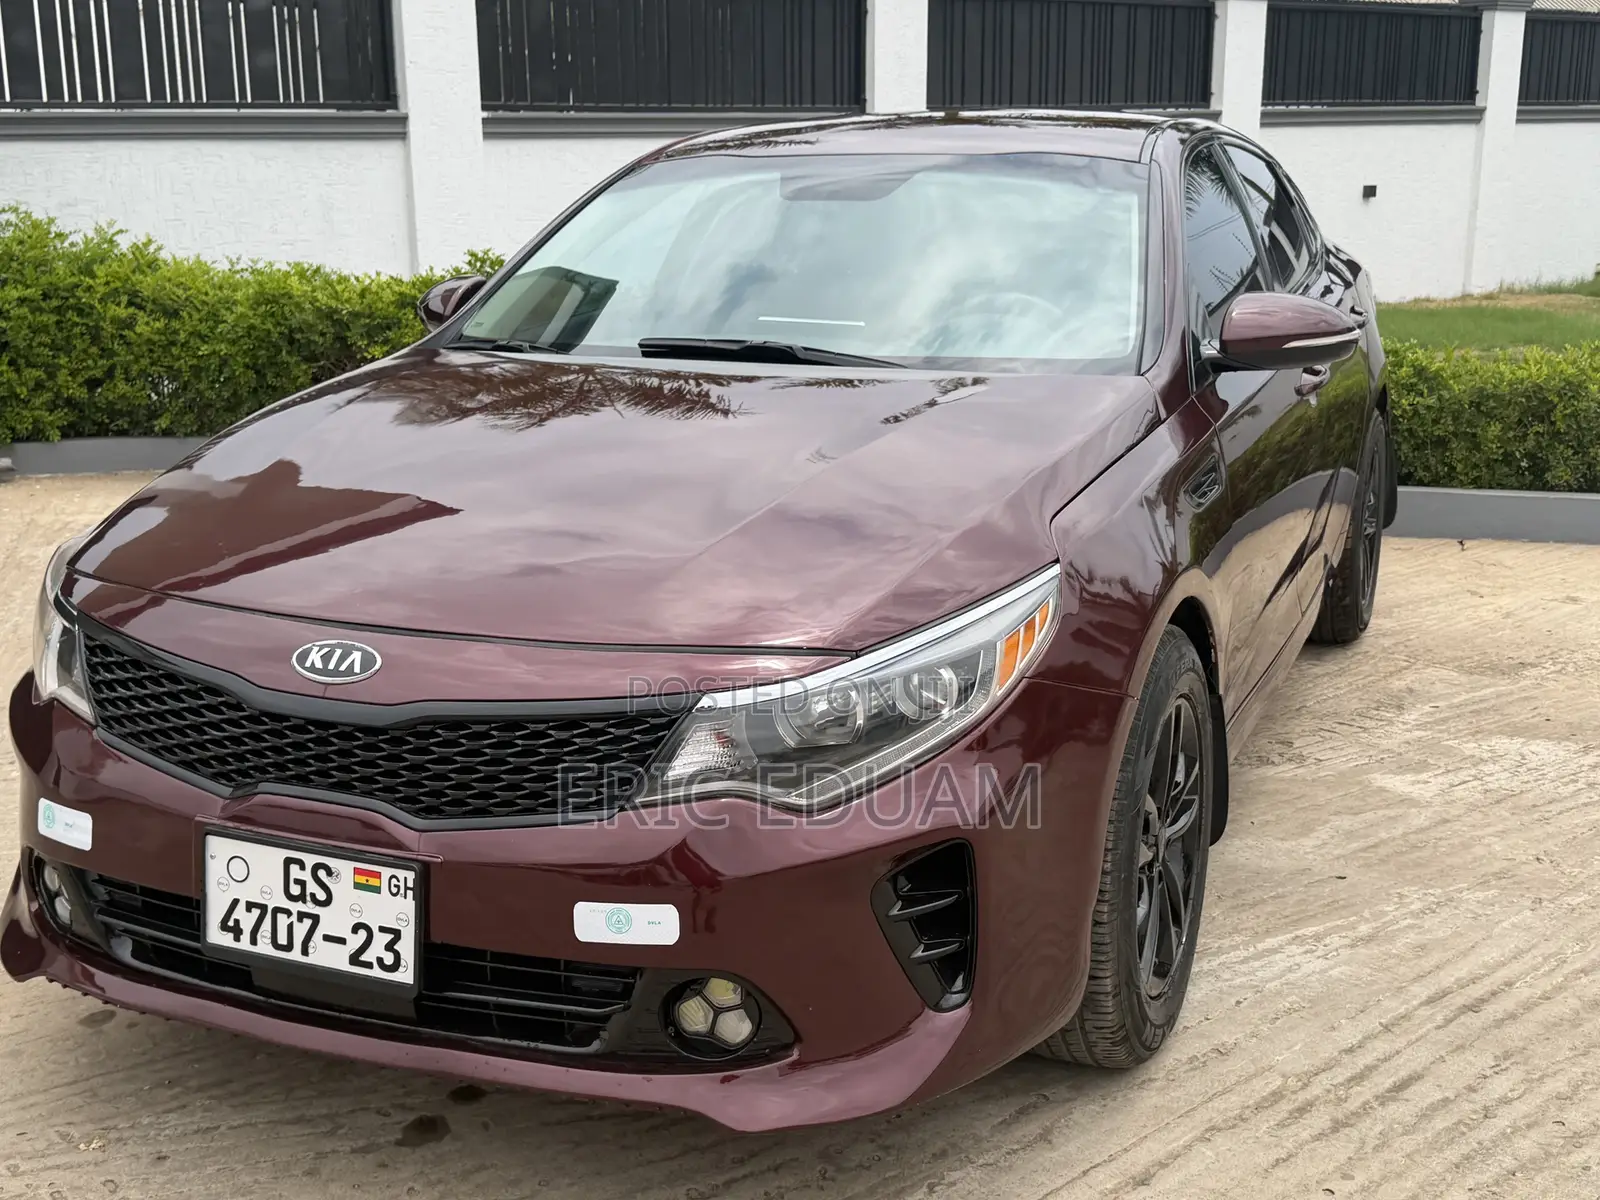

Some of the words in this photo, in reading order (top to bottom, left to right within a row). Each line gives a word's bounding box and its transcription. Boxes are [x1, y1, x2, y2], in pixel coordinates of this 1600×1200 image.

[304, 646, 362, 674] KIA
[282, 856, 334, 908] GS
[388, 874, 415, 901] GH
[219, 898, 402, 974] 4707-23
